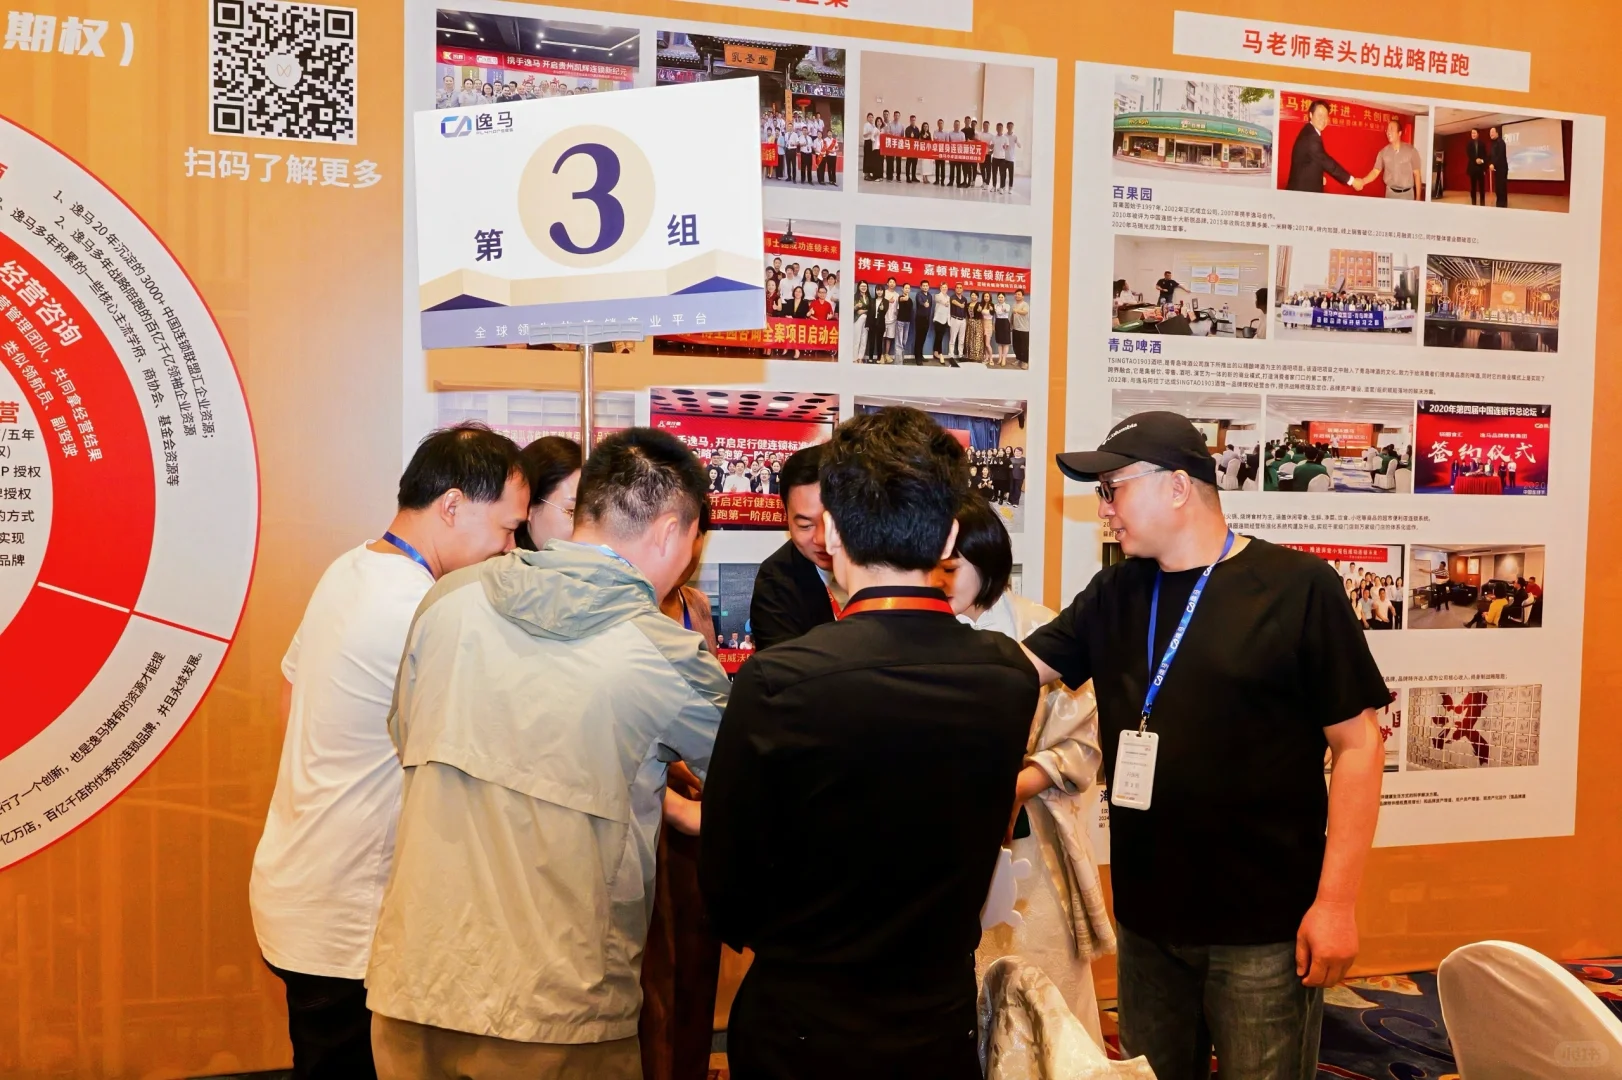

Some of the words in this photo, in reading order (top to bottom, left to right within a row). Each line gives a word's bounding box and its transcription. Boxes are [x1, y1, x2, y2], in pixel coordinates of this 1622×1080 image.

[1242, 29, 1470, 77] 马老师牵头的战略陪跑
[475, 111, 514, 131] 逸马
[184, 147, 383, 189] 扫码了解更多
[474, 229, 504, 262] 第
[549, 143, 625, 255] 3
[667, 214, 699, 247] 组
[1112, 185, 1152, 201] 百果园
[858, 257, 913, 274] 携手逸马
[923, 263, 1027, 283] 嘉顿肯妮连锁新纪元
[0, 259, 83, 347] 经营咨询
[474, 312, 708, 340] 全球领业平台
[1108, 338, 1162, 354] 青岛啤酒
[1, 340, 78, 459] 类似领航员、副驾驶
[1428, 404, 1538, 417] 2020年第四届中国连锁节总论坛
[0, 428, 35, 441] /五年
[1427, 440, 1537, 464] 签约仪式
[14, 465, 41, 478] 授权
[0, 651, 166, 816] 行了一个创新，也是逸马独有的资源才能提
